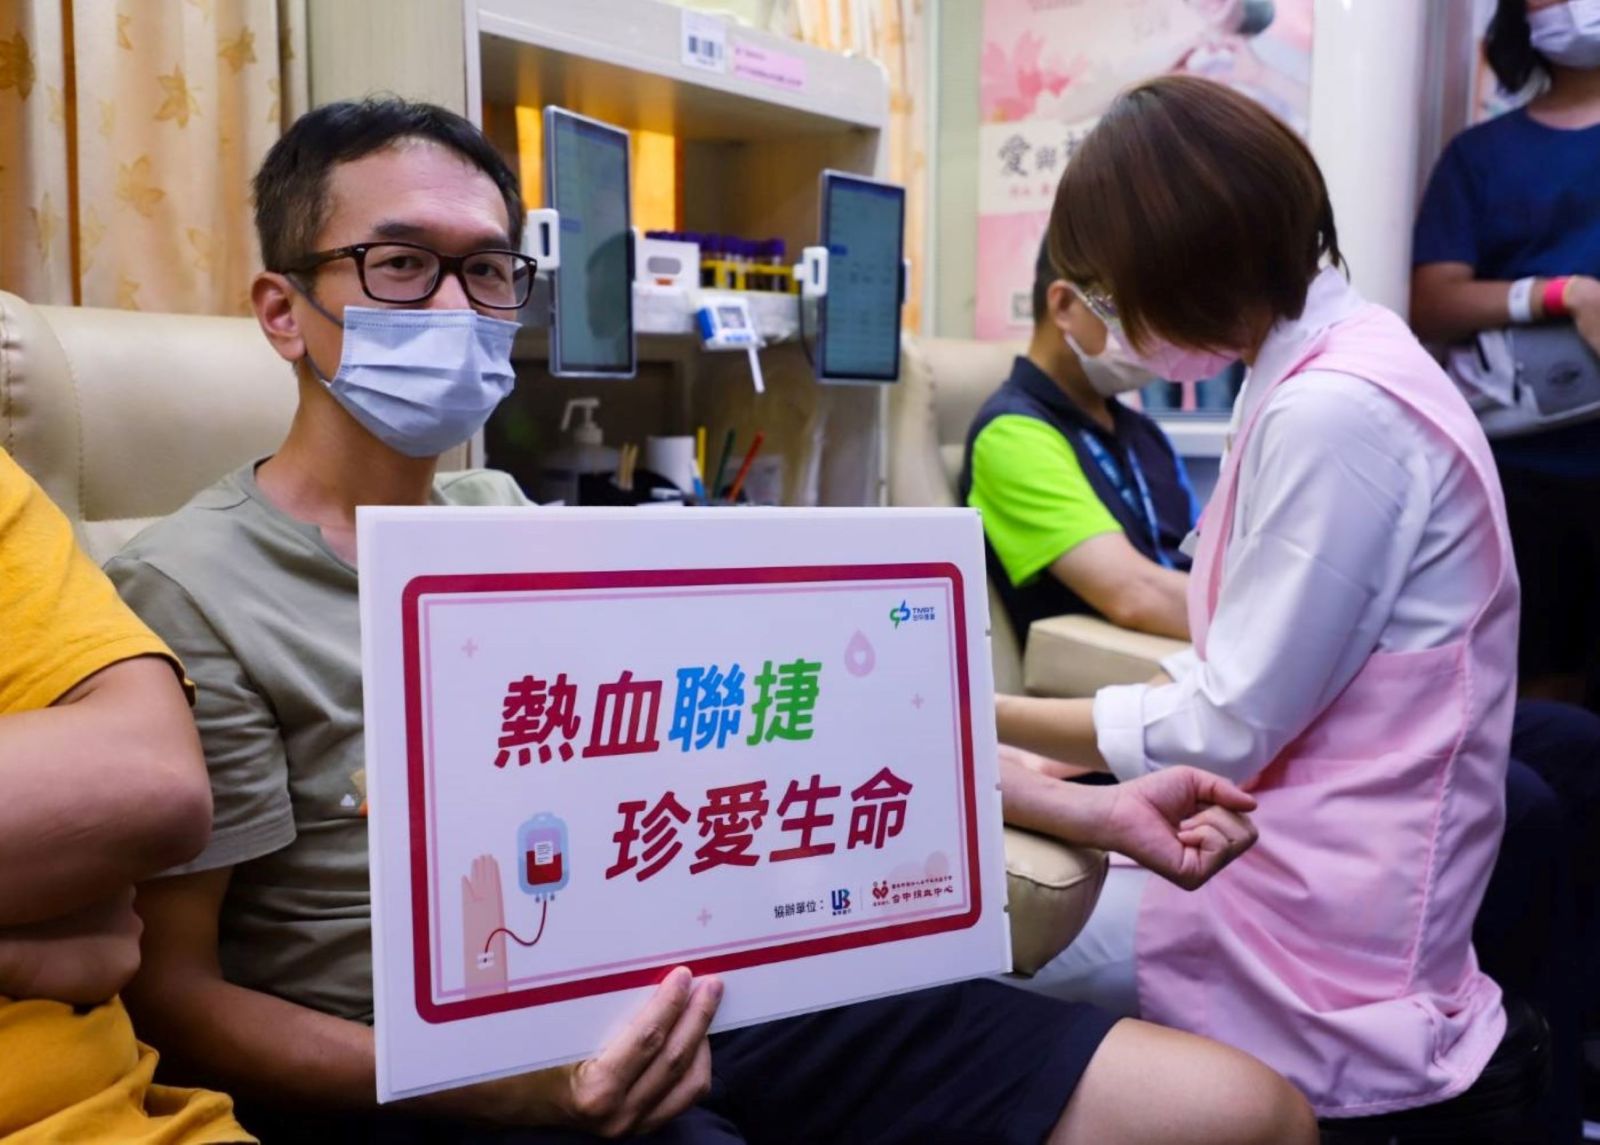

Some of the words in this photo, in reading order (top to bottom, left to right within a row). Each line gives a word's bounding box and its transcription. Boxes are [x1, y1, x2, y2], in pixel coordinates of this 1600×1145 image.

[494, 658, 822, 768] 熱血聯捷
[605, 767, 914, 882] 珍愛生命
